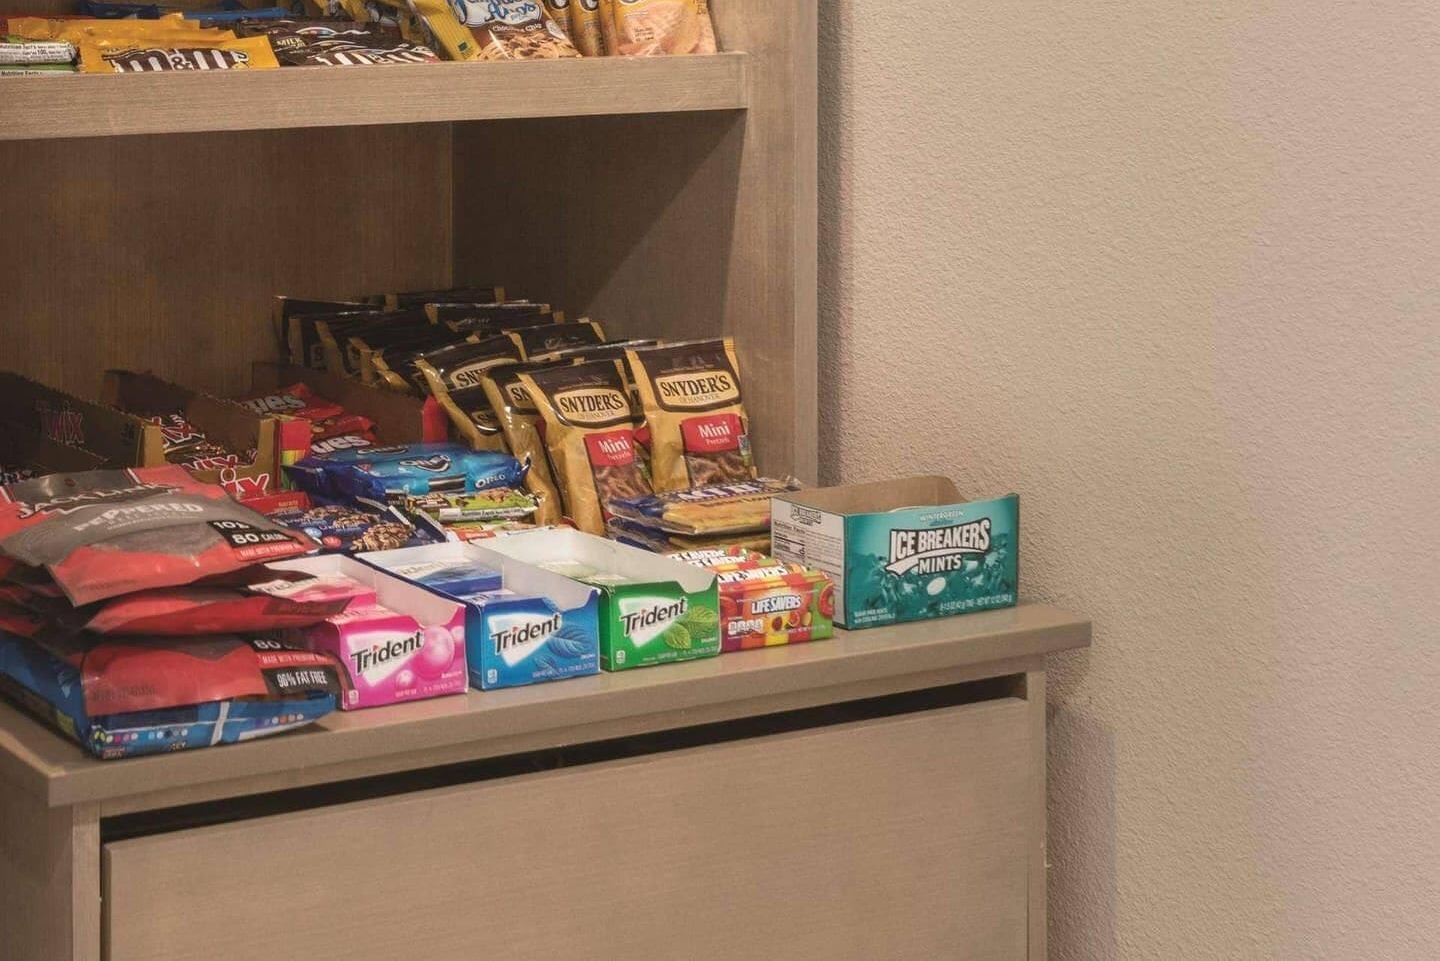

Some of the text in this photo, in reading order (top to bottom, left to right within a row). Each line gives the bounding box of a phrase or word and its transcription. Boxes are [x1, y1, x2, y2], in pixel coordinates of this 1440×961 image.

[660, 375, 731, 397] SNYDER'S
[560, 392, 624, 413] SNYDER'S
[698, 421, 730, 439] Mini
[599, 436, 630, 454] Mini
[919, 510, 965, 521] WINTERGREEN
[232, 532, 259, 545] 80
[891, 519, 992, 563] ICE BREAKERS
[918, 554, 963, 575] MINTS
[620, 597, 687, 638] Trident
[491, 613, 560, 654] Trident
[351, 631, 423, 674] Trident
[296, 672, 310, 686] FAT
[311, 670, 328, 685] FREE
